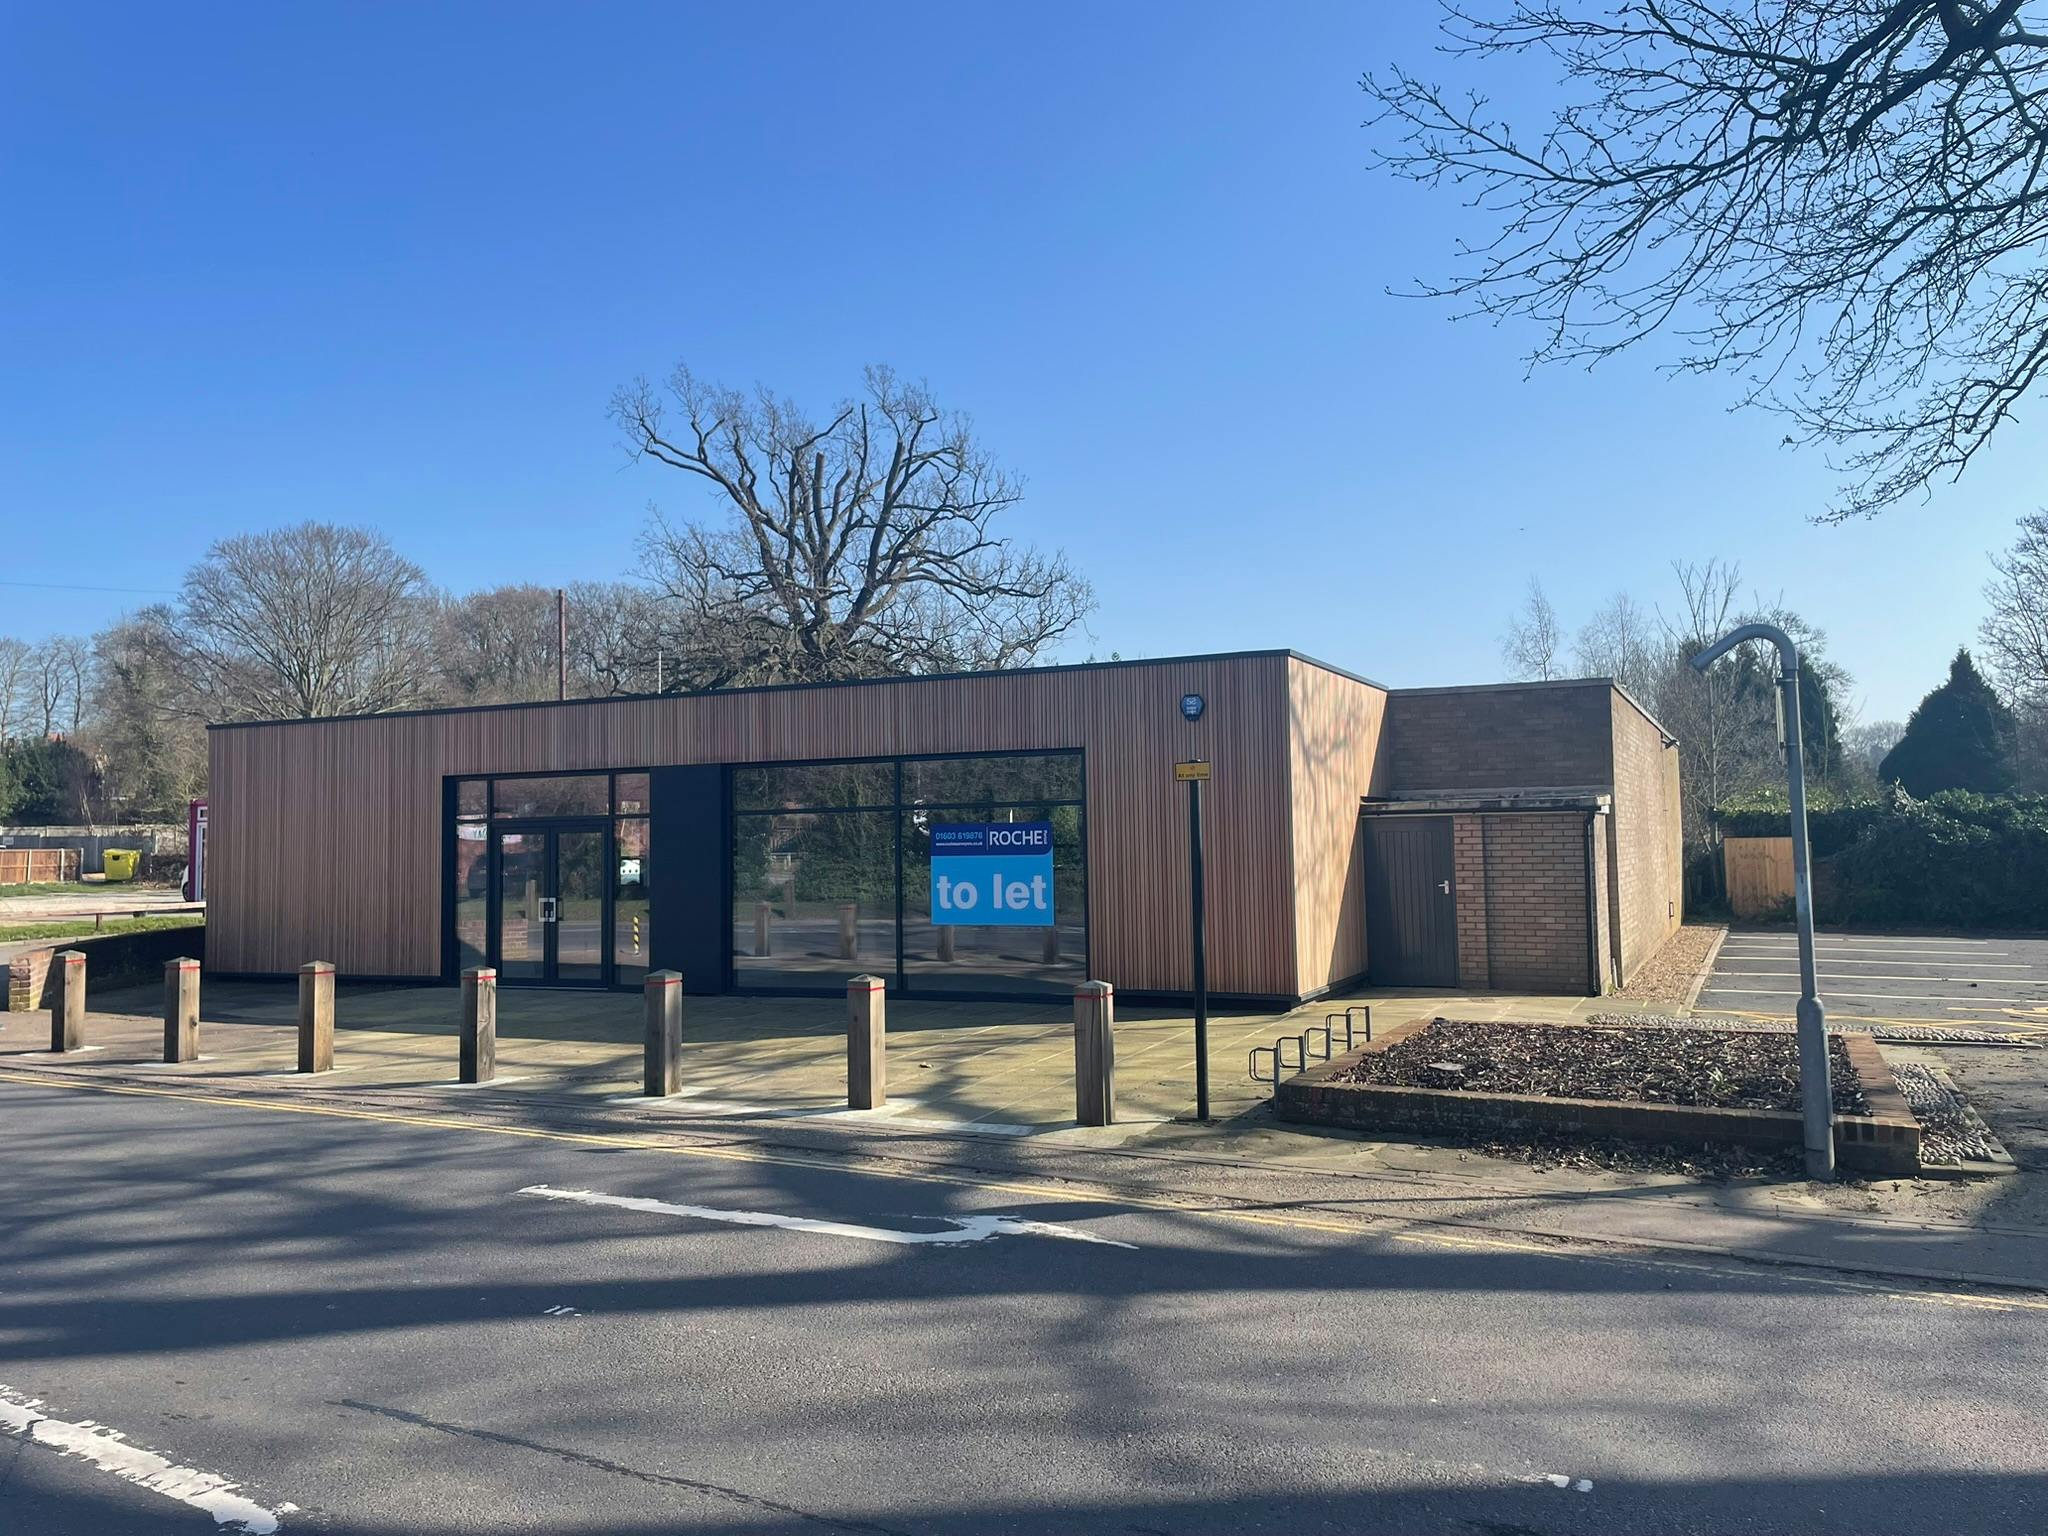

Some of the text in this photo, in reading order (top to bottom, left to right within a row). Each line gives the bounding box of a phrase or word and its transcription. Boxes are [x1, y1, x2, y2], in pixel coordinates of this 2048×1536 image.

[989, 830, 1043, 846] ROCHE
[936, 873, 1047, 910] to let
